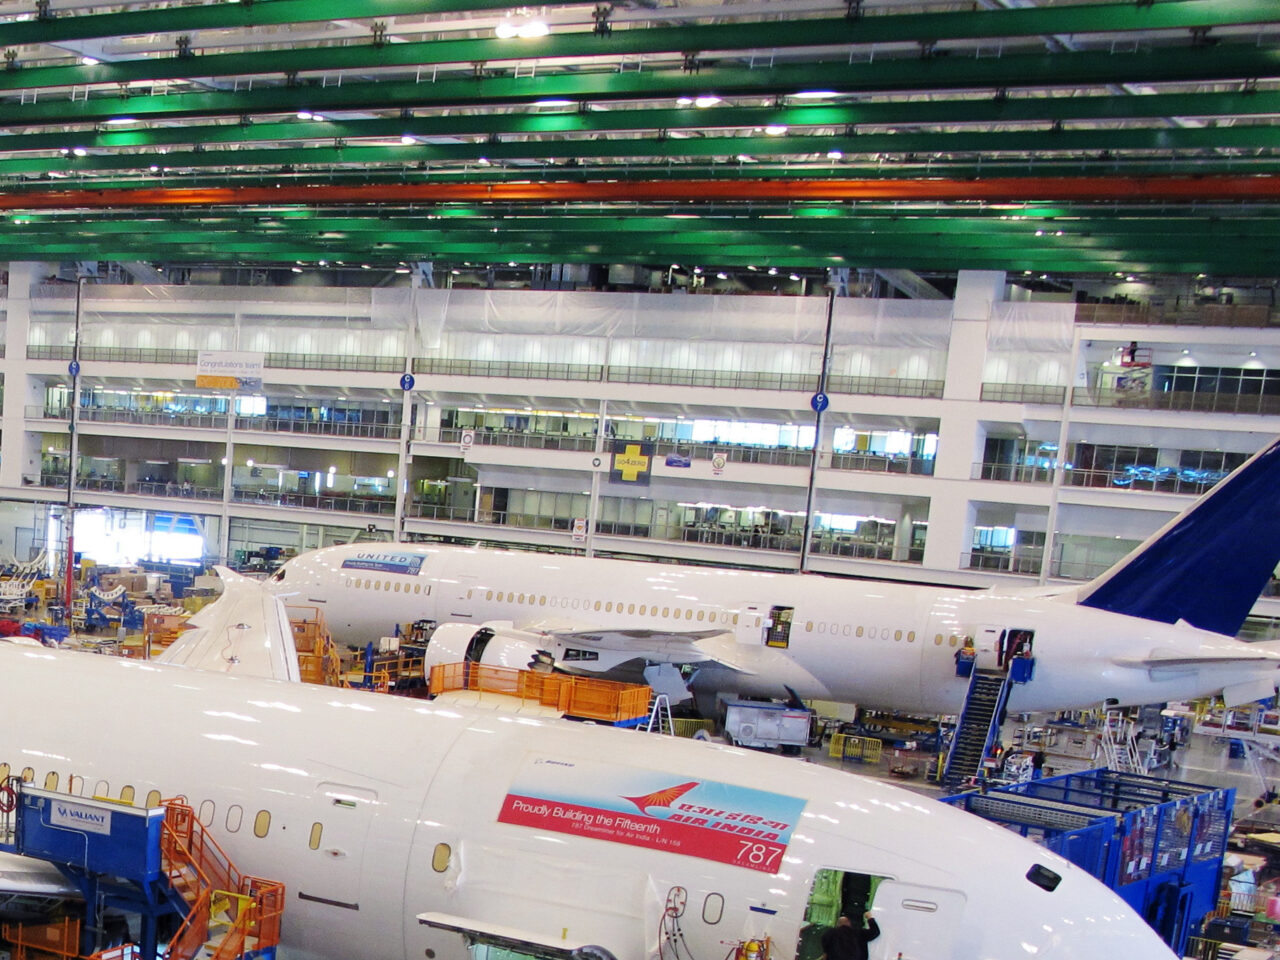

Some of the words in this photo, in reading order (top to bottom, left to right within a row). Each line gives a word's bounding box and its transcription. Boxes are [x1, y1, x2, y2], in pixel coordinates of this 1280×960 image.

[816, 394, 824, 402] C
[357, 552, 407, 563] UNITED
[70, 809, 105, 823] VALIANT
[512, 800, 551, 818] Proudly
[552, 807, 594, 825] Building
[595, 813, 613, 826] the
[614, 817, 661, 835] Fifteenth
[666, 813, 709, 828] AIR
[711, 821, 780, 841] INDIA
[635, 833, 650, 842] India
[737, 840, 782, 866] 787
